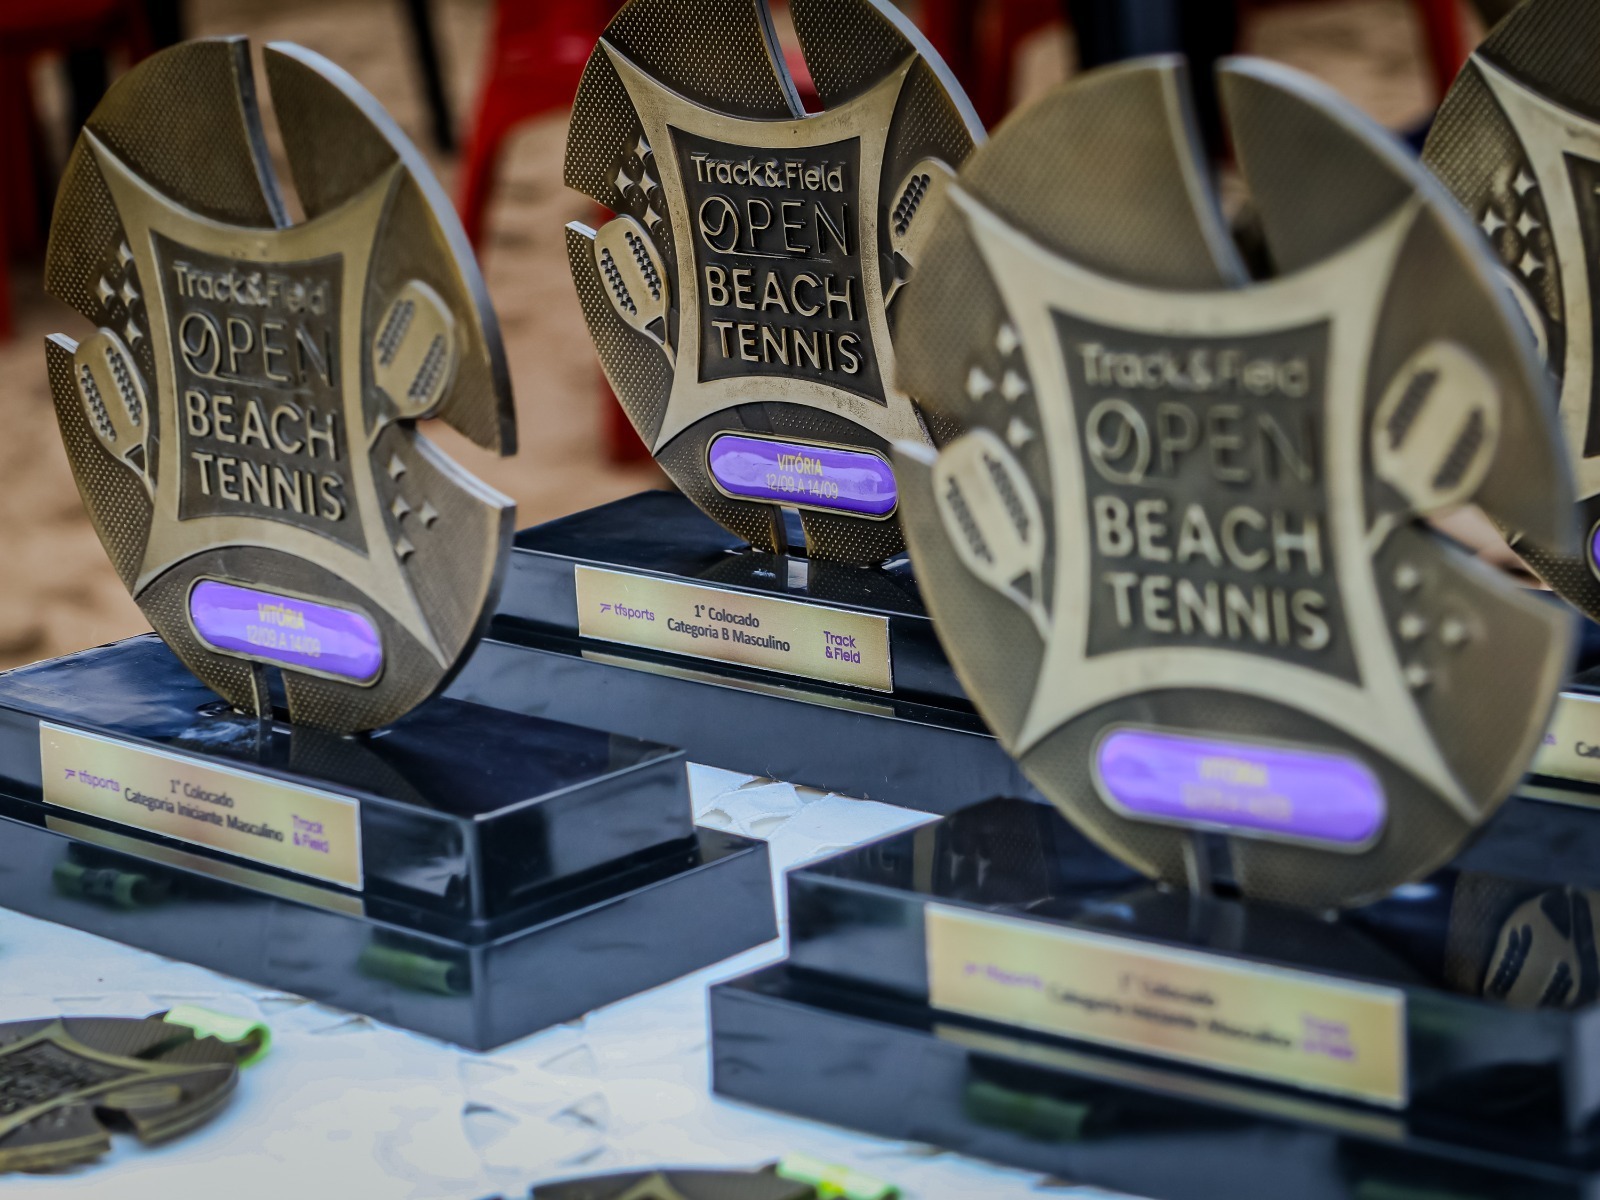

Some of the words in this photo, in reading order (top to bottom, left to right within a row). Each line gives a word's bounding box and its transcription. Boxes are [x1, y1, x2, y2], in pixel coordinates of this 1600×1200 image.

[690, 152, 846, 193] Track&Field
[698, 195, 849, 260] OPEN
[172, 262, 330, 316] Track&Fed
[704, 264, 856, 321] BEACH
[178, 311, 334, 388] OPEN
[711, 319, 861, 375] TENNIS
[184, 390, 338, 461] BEACH
[1085, 398, 1314, 486] OPEN
[190, 451, 346, 521] TENNIS
[765, 473, 795, 494] 12/09
[797, 480, 806, 495] A
[808, 478, 839, 499] 14/09
[777, 452, 824, 477] VITÓRIA
[1093, 494, 1325, 577] BEACH
[614, 603, 655, 622] tfsports
[666, 617, 719, 641] Categoria
[722, 628, 730, 641] B
[732, 631, 791, 653] Masculino
[708, 607, 760, 629] Colocado
[1102, 571, 1331, 651] TENNIS
[823, 630, 857, 650] Track
